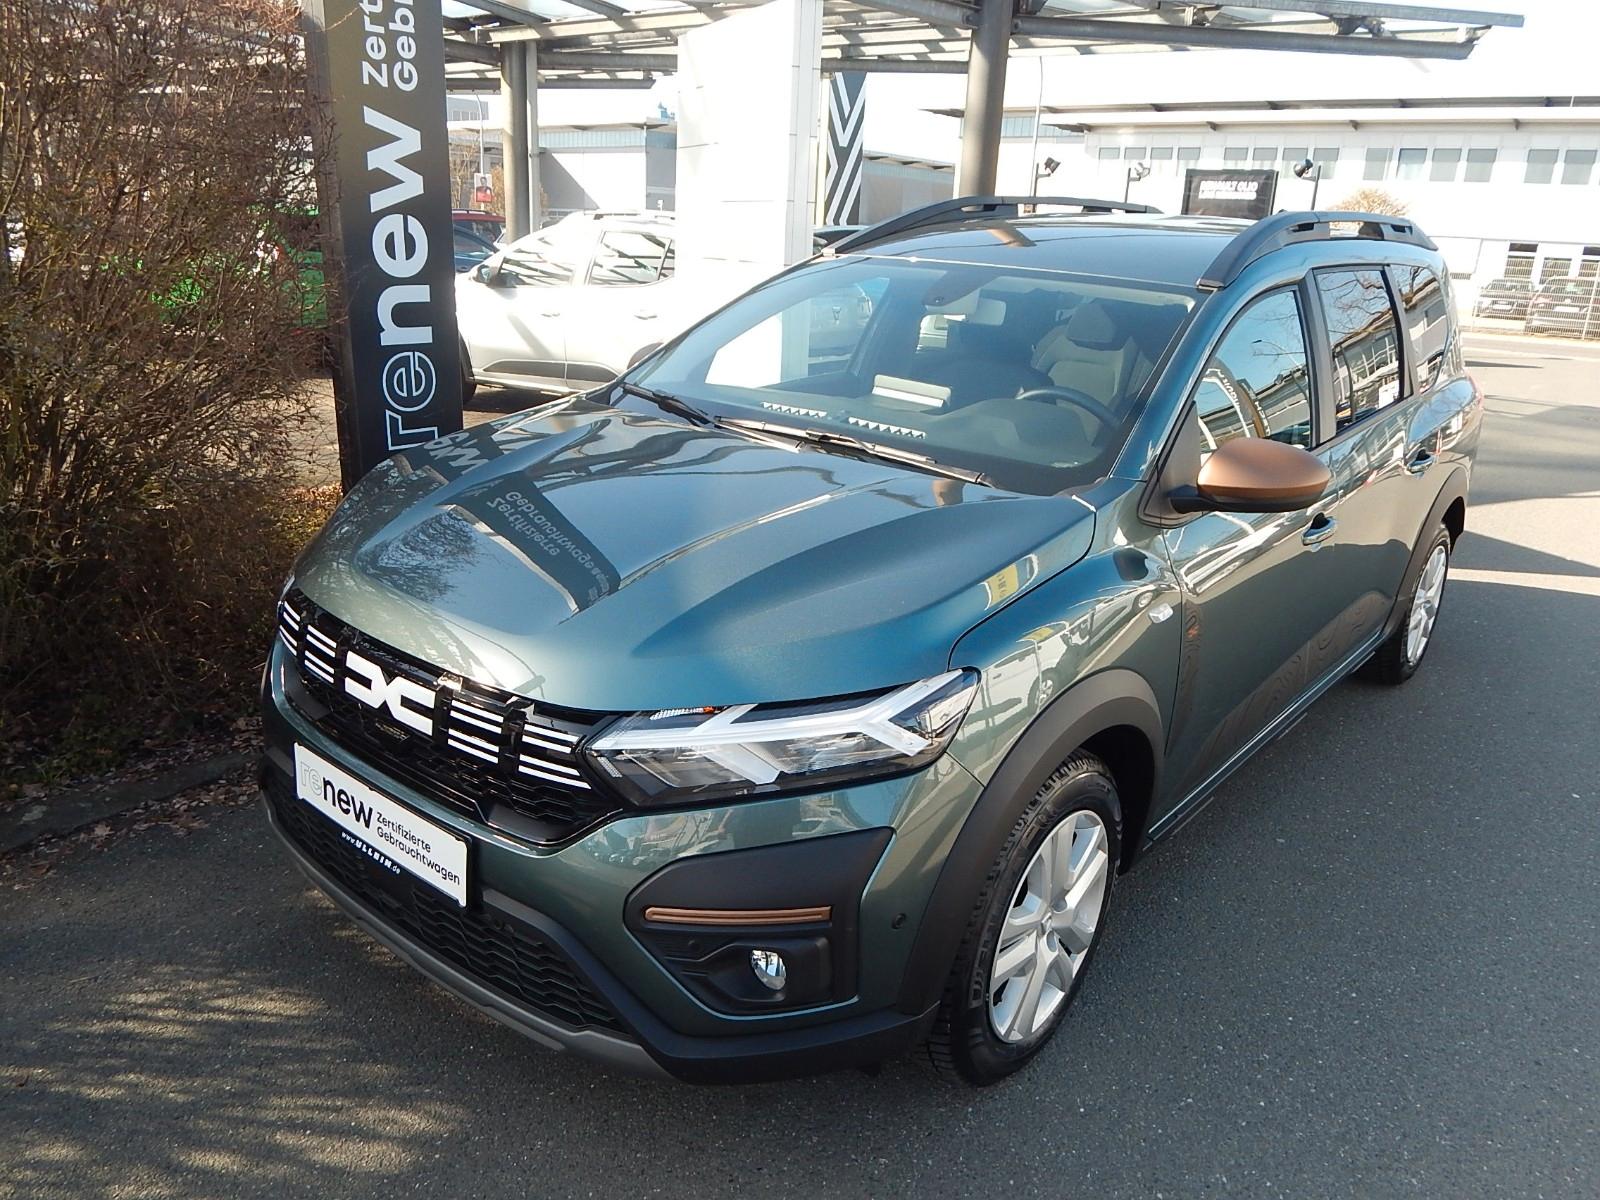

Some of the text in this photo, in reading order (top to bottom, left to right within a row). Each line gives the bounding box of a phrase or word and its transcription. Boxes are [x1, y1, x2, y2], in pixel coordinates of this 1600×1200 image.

[362, 105, 439, 451] renew
[300, 760, 374, 830] renew
[375, 811, 432, 853] Zertifizierte
[376, 827, 461, 886] Gebrauchtwagen
